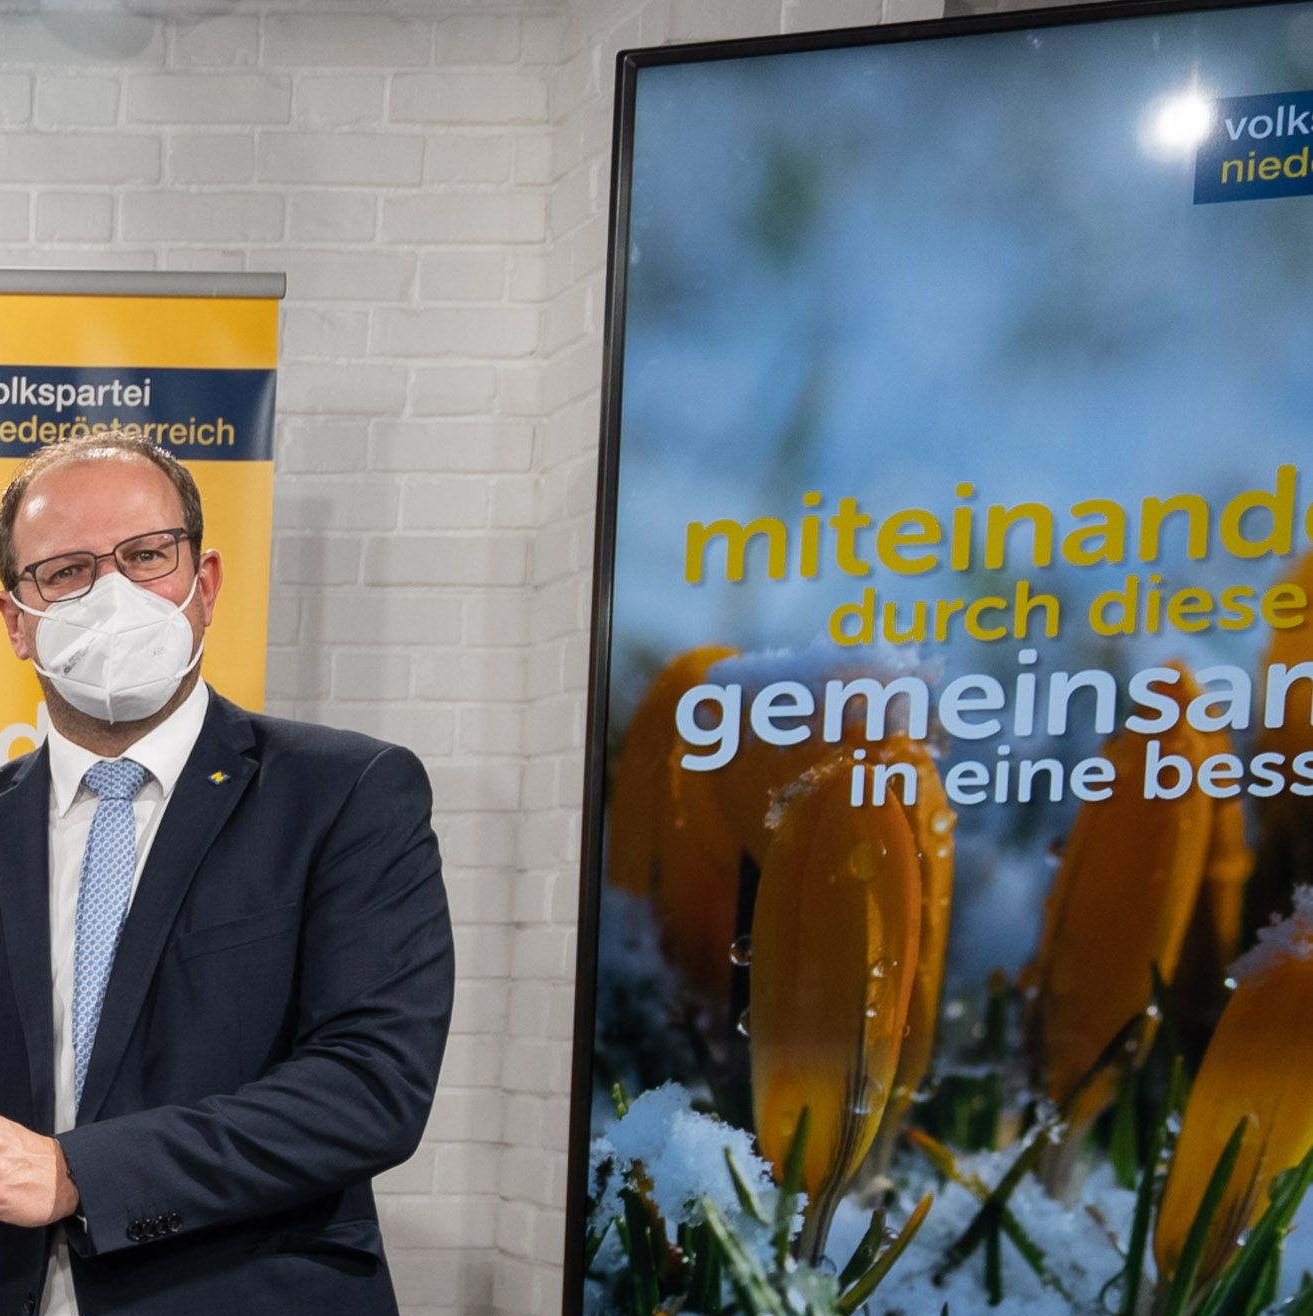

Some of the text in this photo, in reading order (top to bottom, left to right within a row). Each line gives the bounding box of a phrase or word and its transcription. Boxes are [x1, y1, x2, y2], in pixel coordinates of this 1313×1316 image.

[1225, 105, 1313, 141] volk
[1221, 146, 1313, 184] nied
[685, 464, 1313, 583] miteinand
[829, 573, 1307, 647] durch diese
[850, 749, 918, 807] in
[945, 745, 1116, 805] eine
